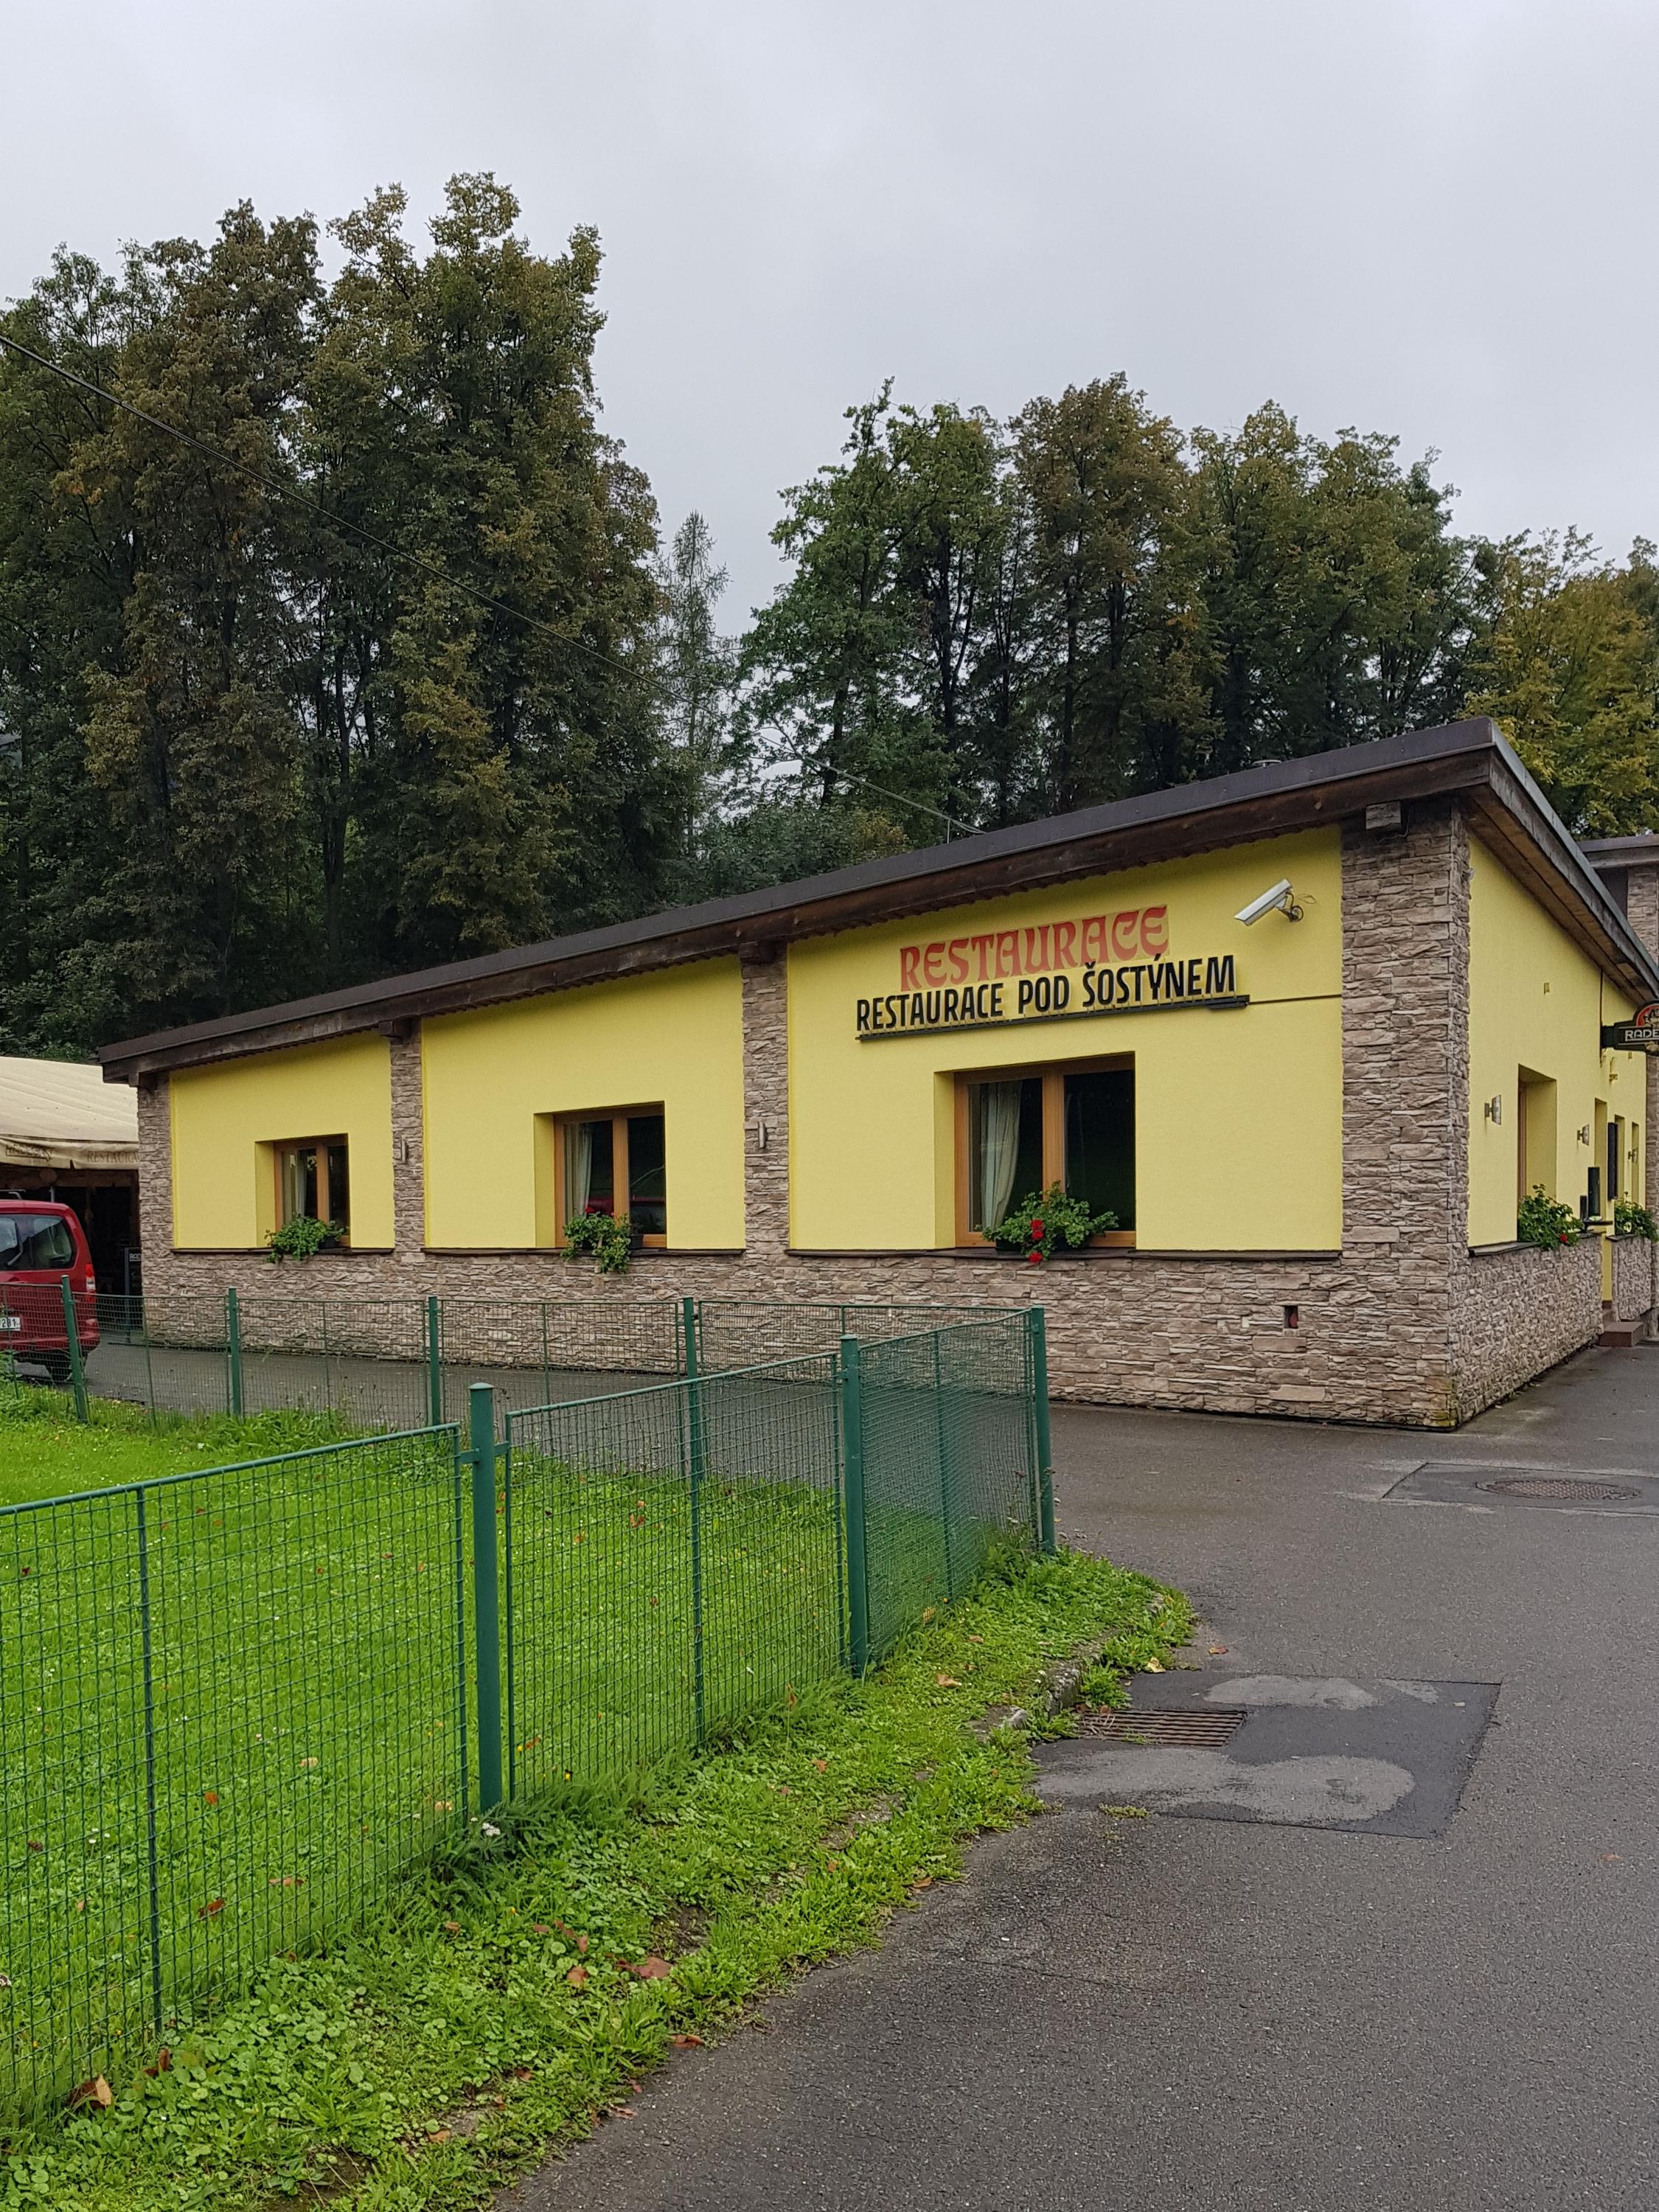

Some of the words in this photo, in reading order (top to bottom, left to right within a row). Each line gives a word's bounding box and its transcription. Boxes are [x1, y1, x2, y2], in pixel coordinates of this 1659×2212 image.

[900, 905, 1169, 992] RESTAURACE
[857, 983, 1004, 1032] RESTAURACE
[1018, 975, 1069, 1015] POD
[1082, 953, 1235, 1008] ŠOSTÝNEM
[87, 1150, 140, 1164] RESTAURA
